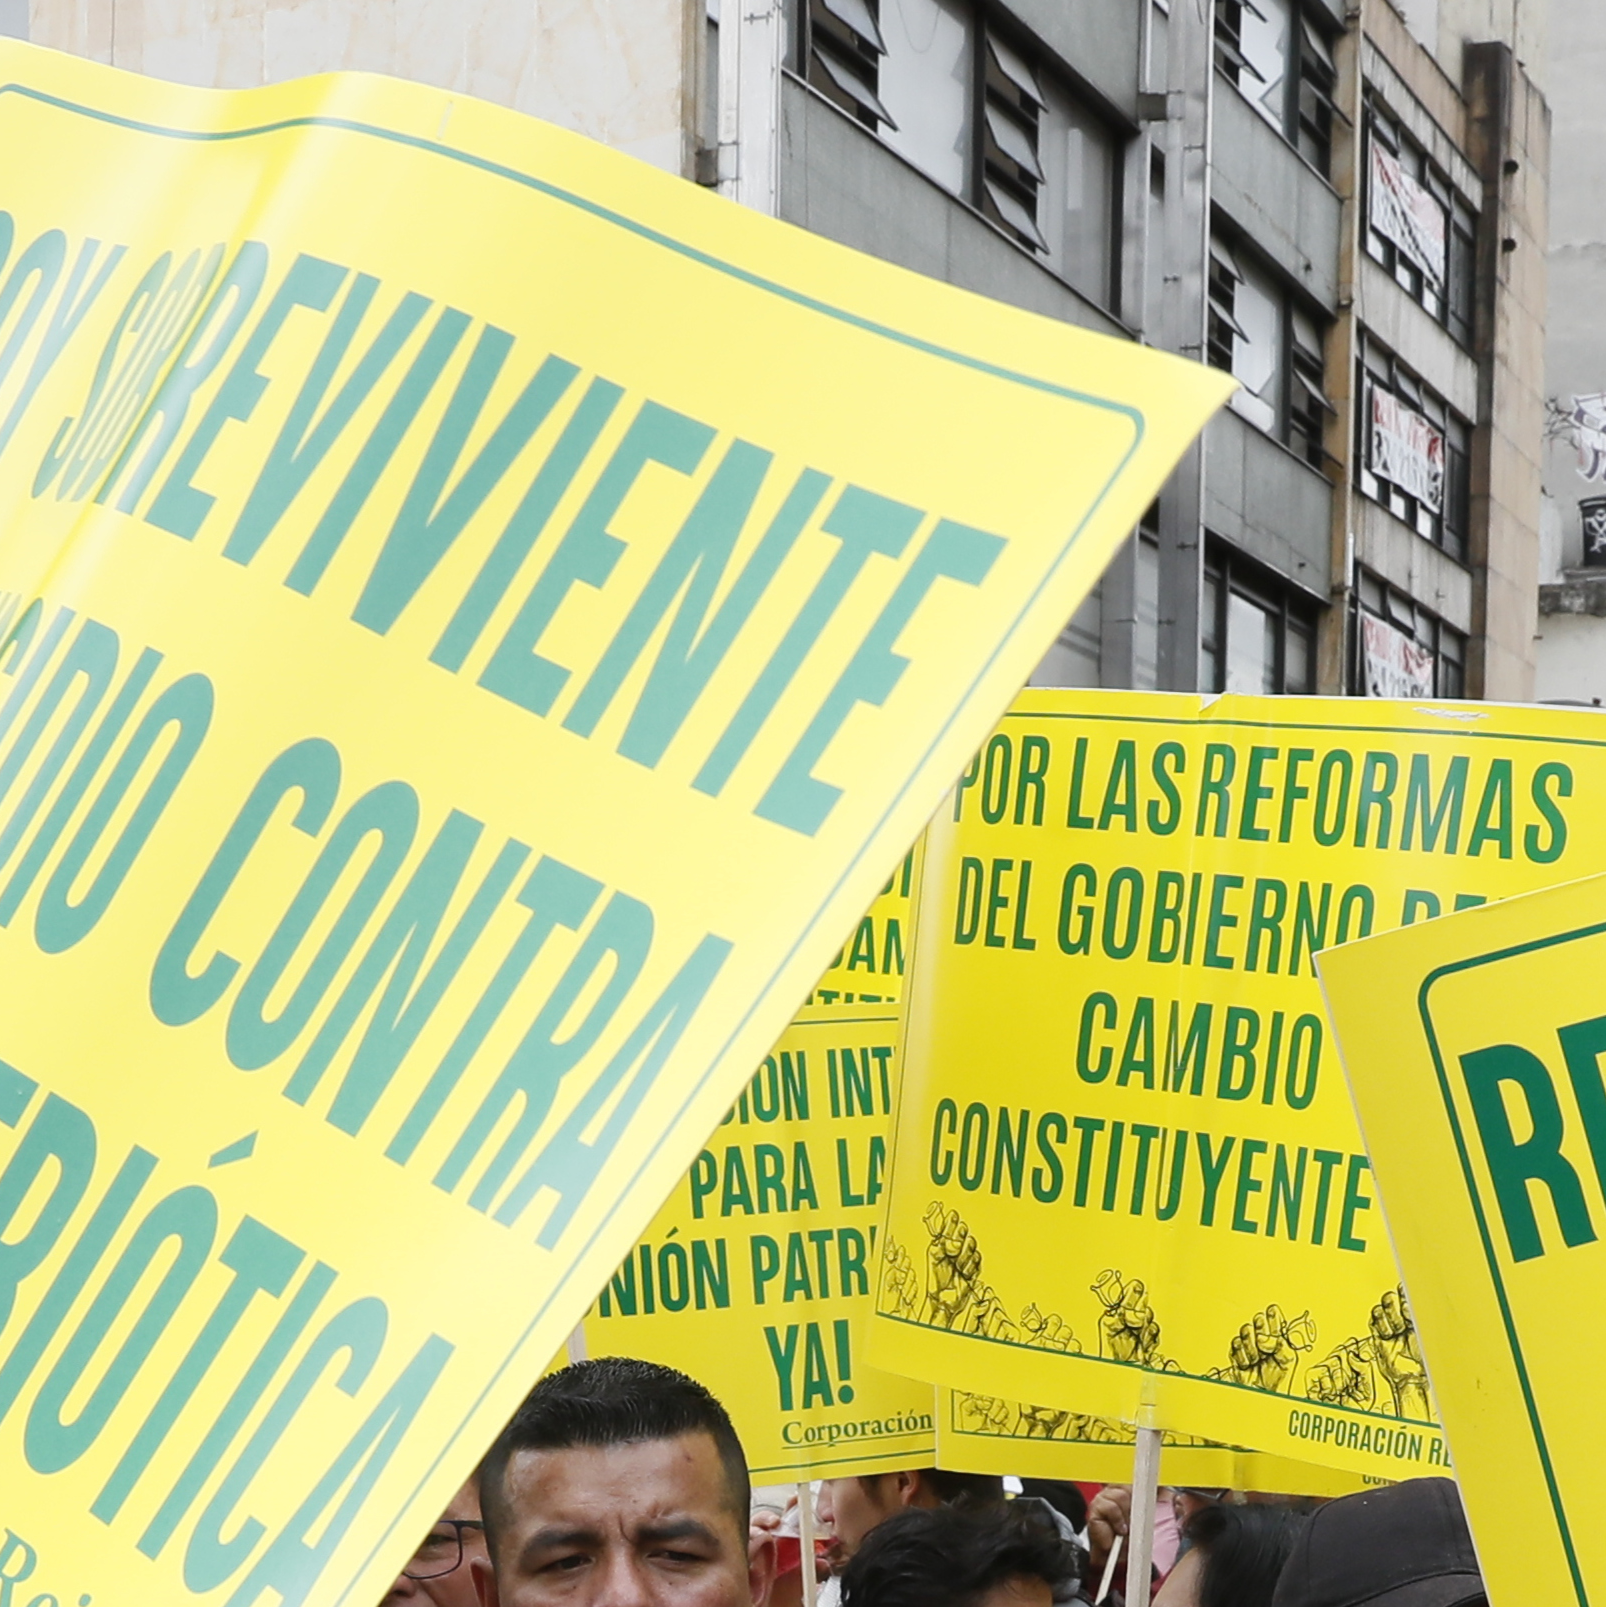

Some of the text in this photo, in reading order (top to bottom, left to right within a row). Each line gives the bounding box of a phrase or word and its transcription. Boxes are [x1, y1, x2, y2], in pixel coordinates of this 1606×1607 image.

[1066, 736, 1185, 837] LAS
[1195, 743, 1573, 864] REFORMAS
[954, 856, 1036, 951] DEL
[148, 738, 734, 1251] CONTRA
[1076, 991, 1324, 1111] CAMBIO
[690, 1140, 819, 1220] PARA
[929, 1097, 1372, 1253] CONSTITUYENTE
[583, 1225, 878, 1320] NIÓN PATR
[765, 1319, 854, 1412] YA!
[781, 1410, 933, 1450] Corporación
[1287, 1409, 1424, 1462] CORPORACIÓN
